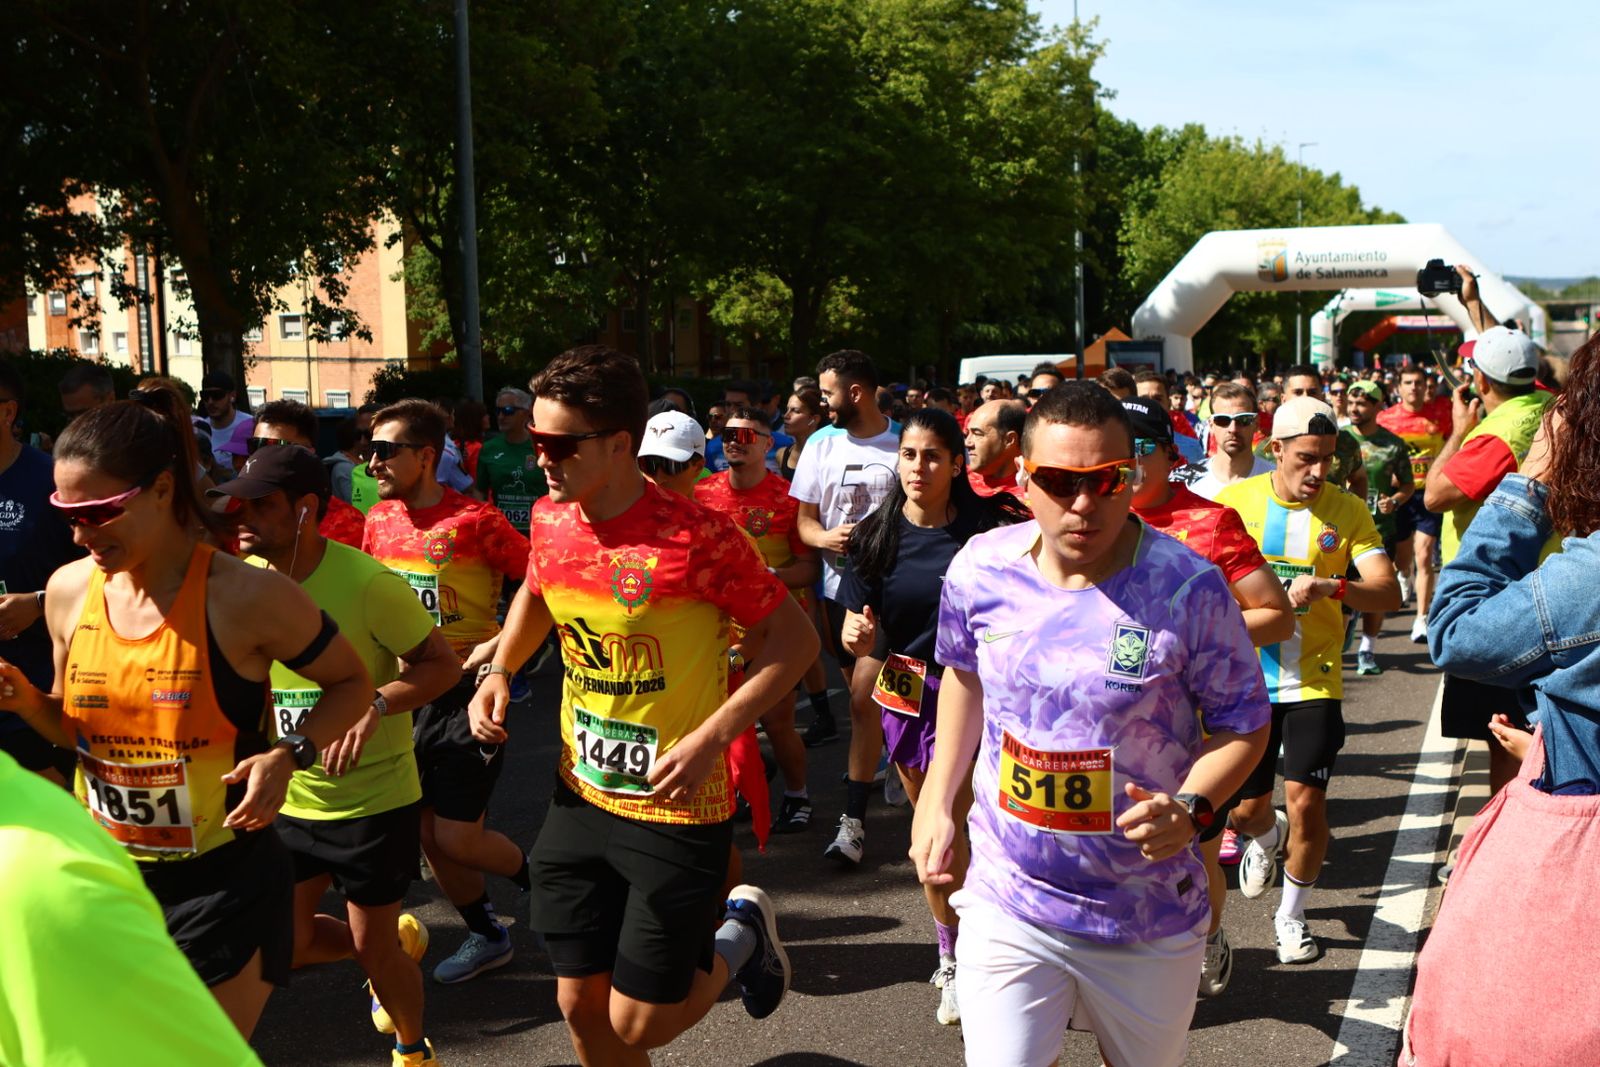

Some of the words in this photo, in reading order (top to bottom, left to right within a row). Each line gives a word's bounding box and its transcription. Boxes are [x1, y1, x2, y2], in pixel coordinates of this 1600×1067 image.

[1295, 250, 1388, 265] Ayuntamiento
[1295, 268, 1312, 280] de
[1316, 266, 1388, 280] Salamanca
[583, 676, 633, 696] FERNANDO
[635, 676, 666, 695] 2026
[1105, 680, 1143, 693] KOREA
[91, 735, 145, 746] ESCUELA
[577, 731, 650, 777] 1449
[1022, 754, 1078, 771] CARRERA
[1011, 763, 1092, 810] 518
[91, 778, 181, 824] 1851
